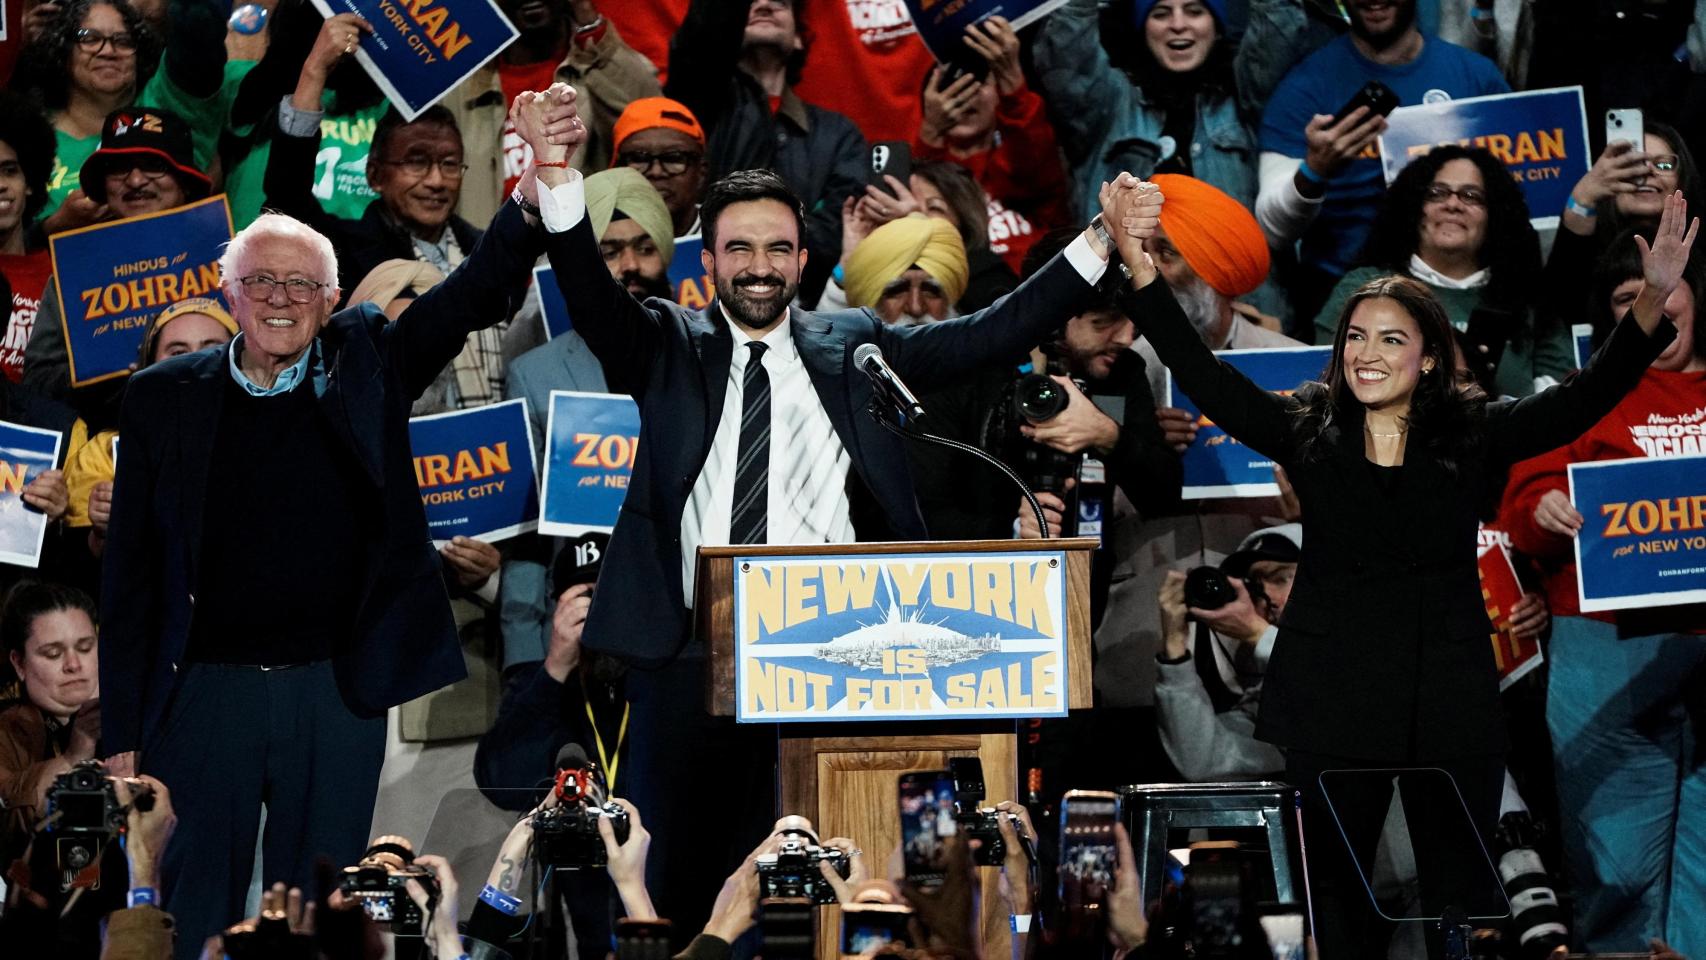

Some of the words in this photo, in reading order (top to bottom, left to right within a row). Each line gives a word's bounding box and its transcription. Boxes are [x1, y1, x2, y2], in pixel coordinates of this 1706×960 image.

[379, 0, 412, 36] YORK
[407, 34, 438, 65] CITY
[1527, 167, 1561, 182] CITY
[113, 256, 169, 278] HINDUS
[80, 260, 222, 321] ZOHRAN
[112, 314, 149, 331] NEW
[421, 488, 465, 506] YORK
[468, 480, 505, 498] CITY
[604, 474, 631, 489] NE
[1639, 538, 1679, 554] NEW
[745, 563, 881, 645] NEW
[886, 560, 1056, 639] YORK
[882, 647, 928, 675] IS
[747, 655, 841, 713] NOT
[845, 677, 933, 711] FOR
[945, 650, 1057, 709] SALE
